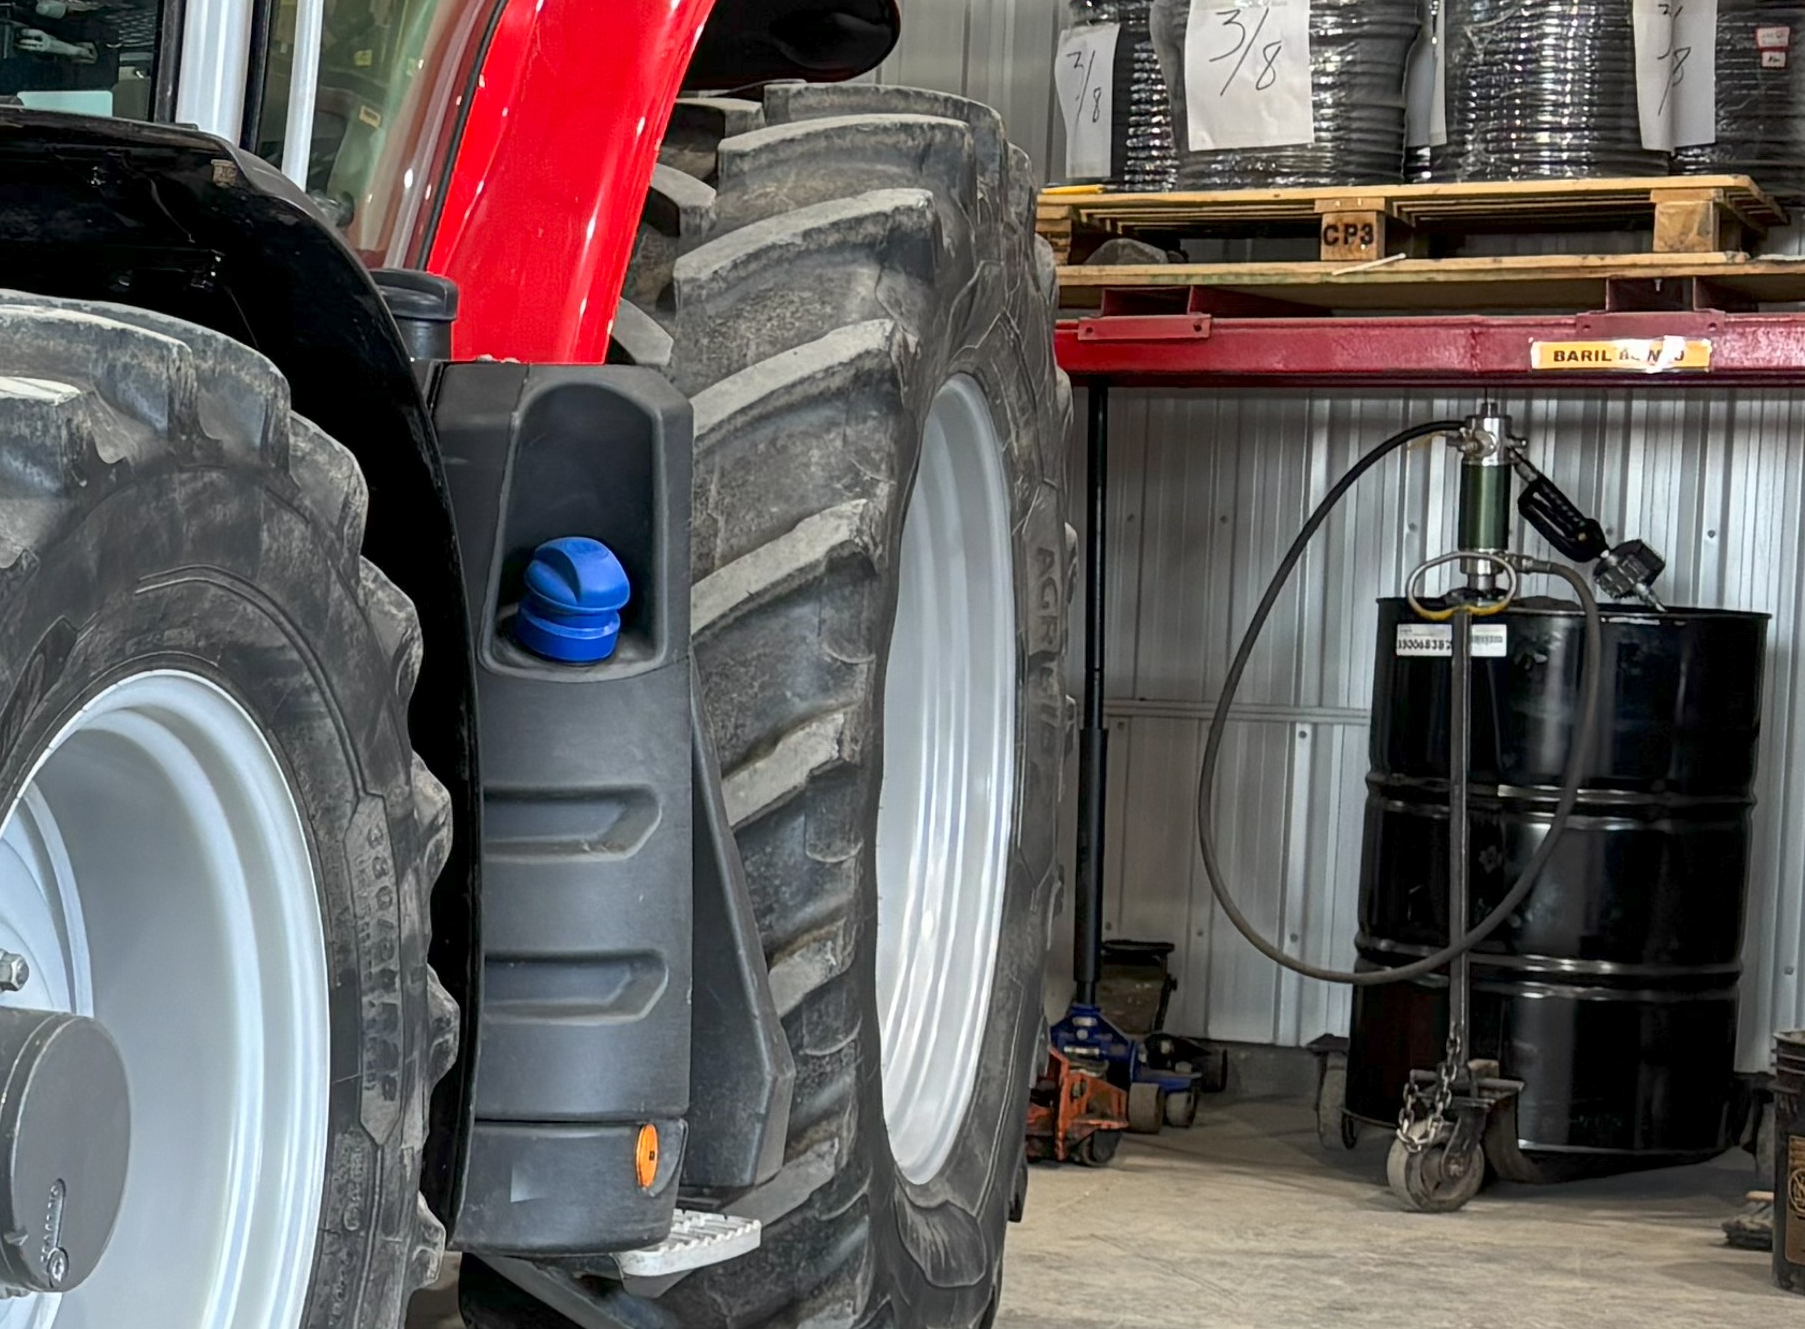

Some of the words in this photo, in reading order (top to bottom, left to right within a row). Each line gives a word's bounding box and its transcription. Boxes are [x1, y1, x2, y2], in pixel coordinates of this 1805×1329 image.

[1209, 7, 1283, 98] 3/8
[1066, 50, 1102, 124] 3/8
[1323, 223, 1375, 246] CP3
[1553, 349, 1612, 362] BARIL
